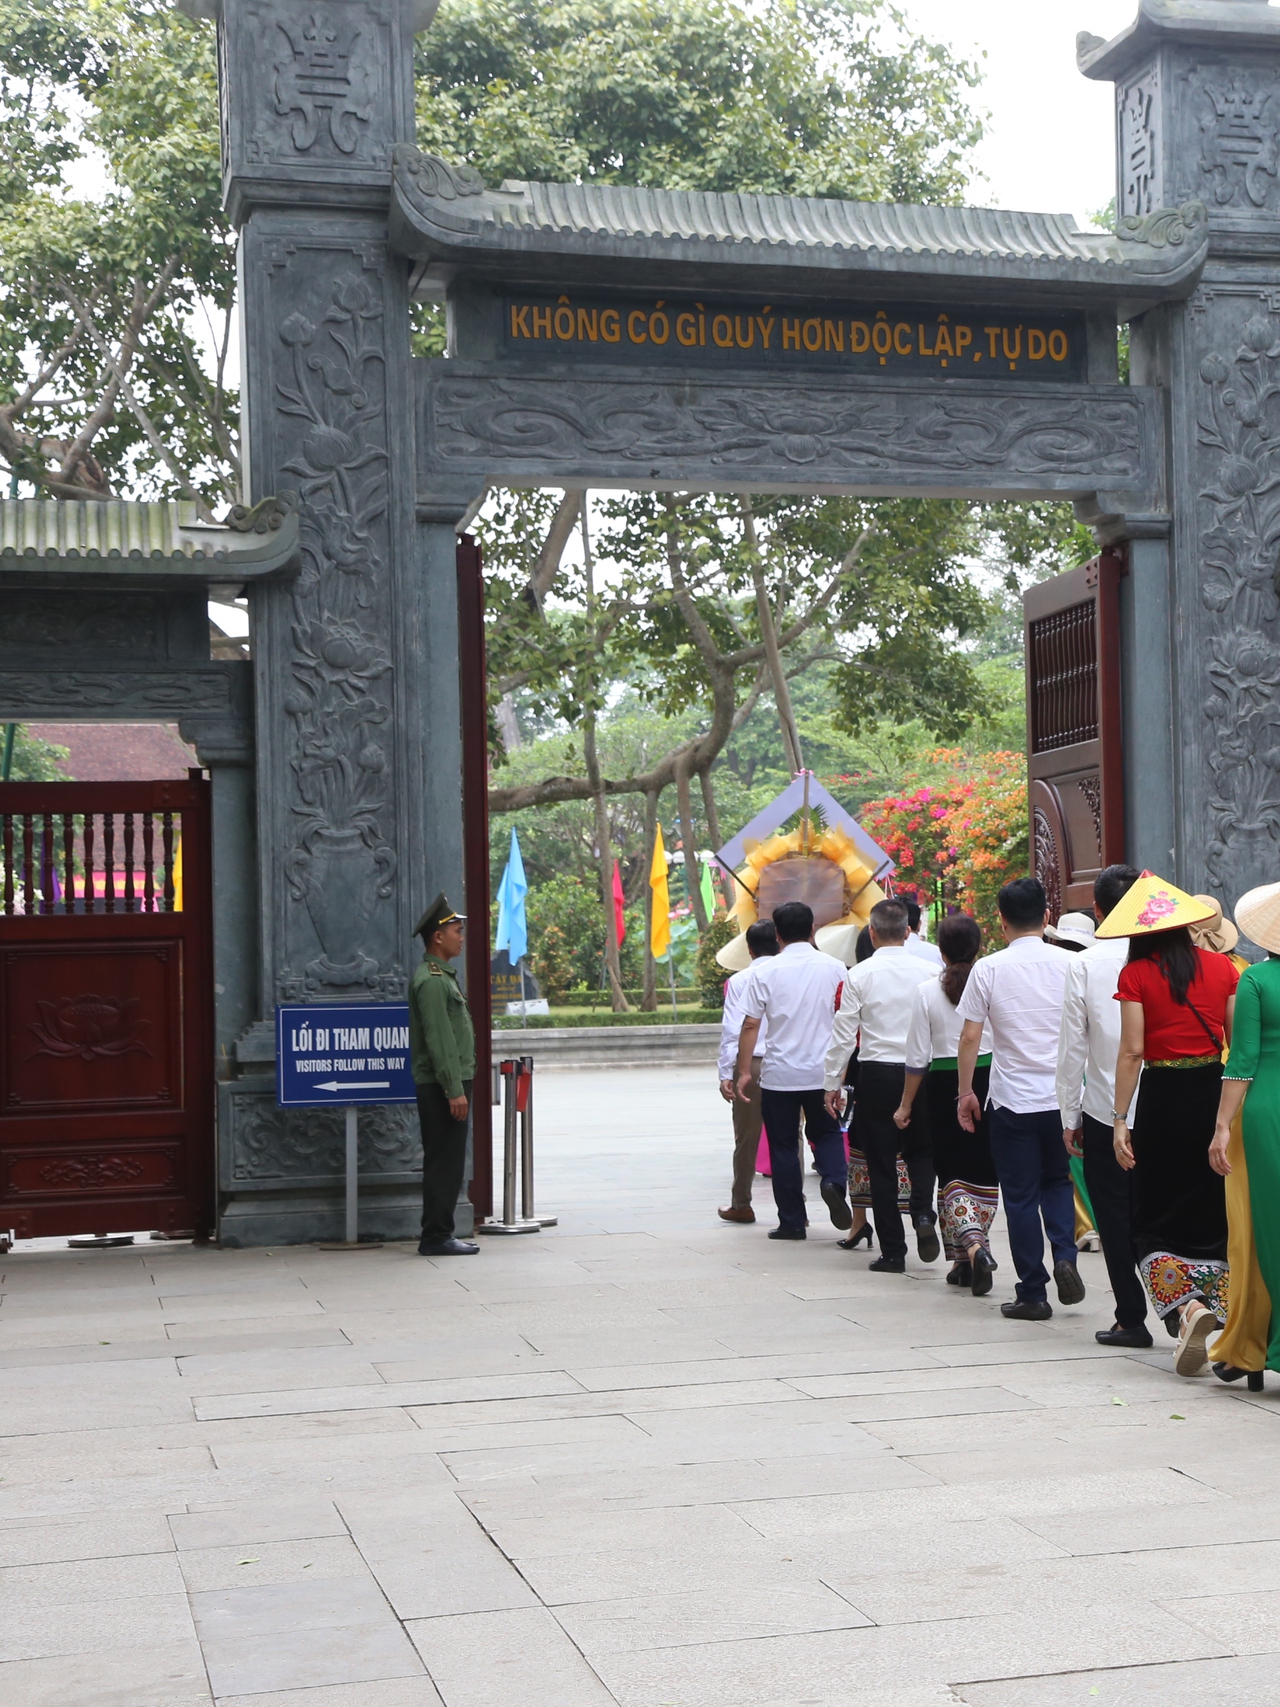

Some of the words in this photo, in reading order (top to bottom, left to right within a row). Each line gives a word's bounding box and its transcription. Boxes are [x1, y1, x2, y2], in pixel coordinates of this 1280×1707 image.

[511, 295, 621, 343] KHÔNG
[627, 301, 669, 345] CÓ
[675, 302, 706, 346] GÌ
[712, 305, 775, 349] QUÝ
[782, 317, 844, 352] HƠN
[849, 311, 912, 366] ĐỘC
[984, 325, 1023, 371] TỰ
[1028, 328, 1068, 362] DO
[292, 1020, 313, 1052] LỐI
[315, 1028, 330, 1051] ĐI
[333, 1027, 370, 1051] THAM
[373, 1027, 410, 1052] QUAN
[295, 1060, 332, 1073] VISITORS
[333, 1058, 366, 1072] FOLLOW
[367, 1057, 385, 1070] THIS
[386, 1057, 406, 1070] WAY
